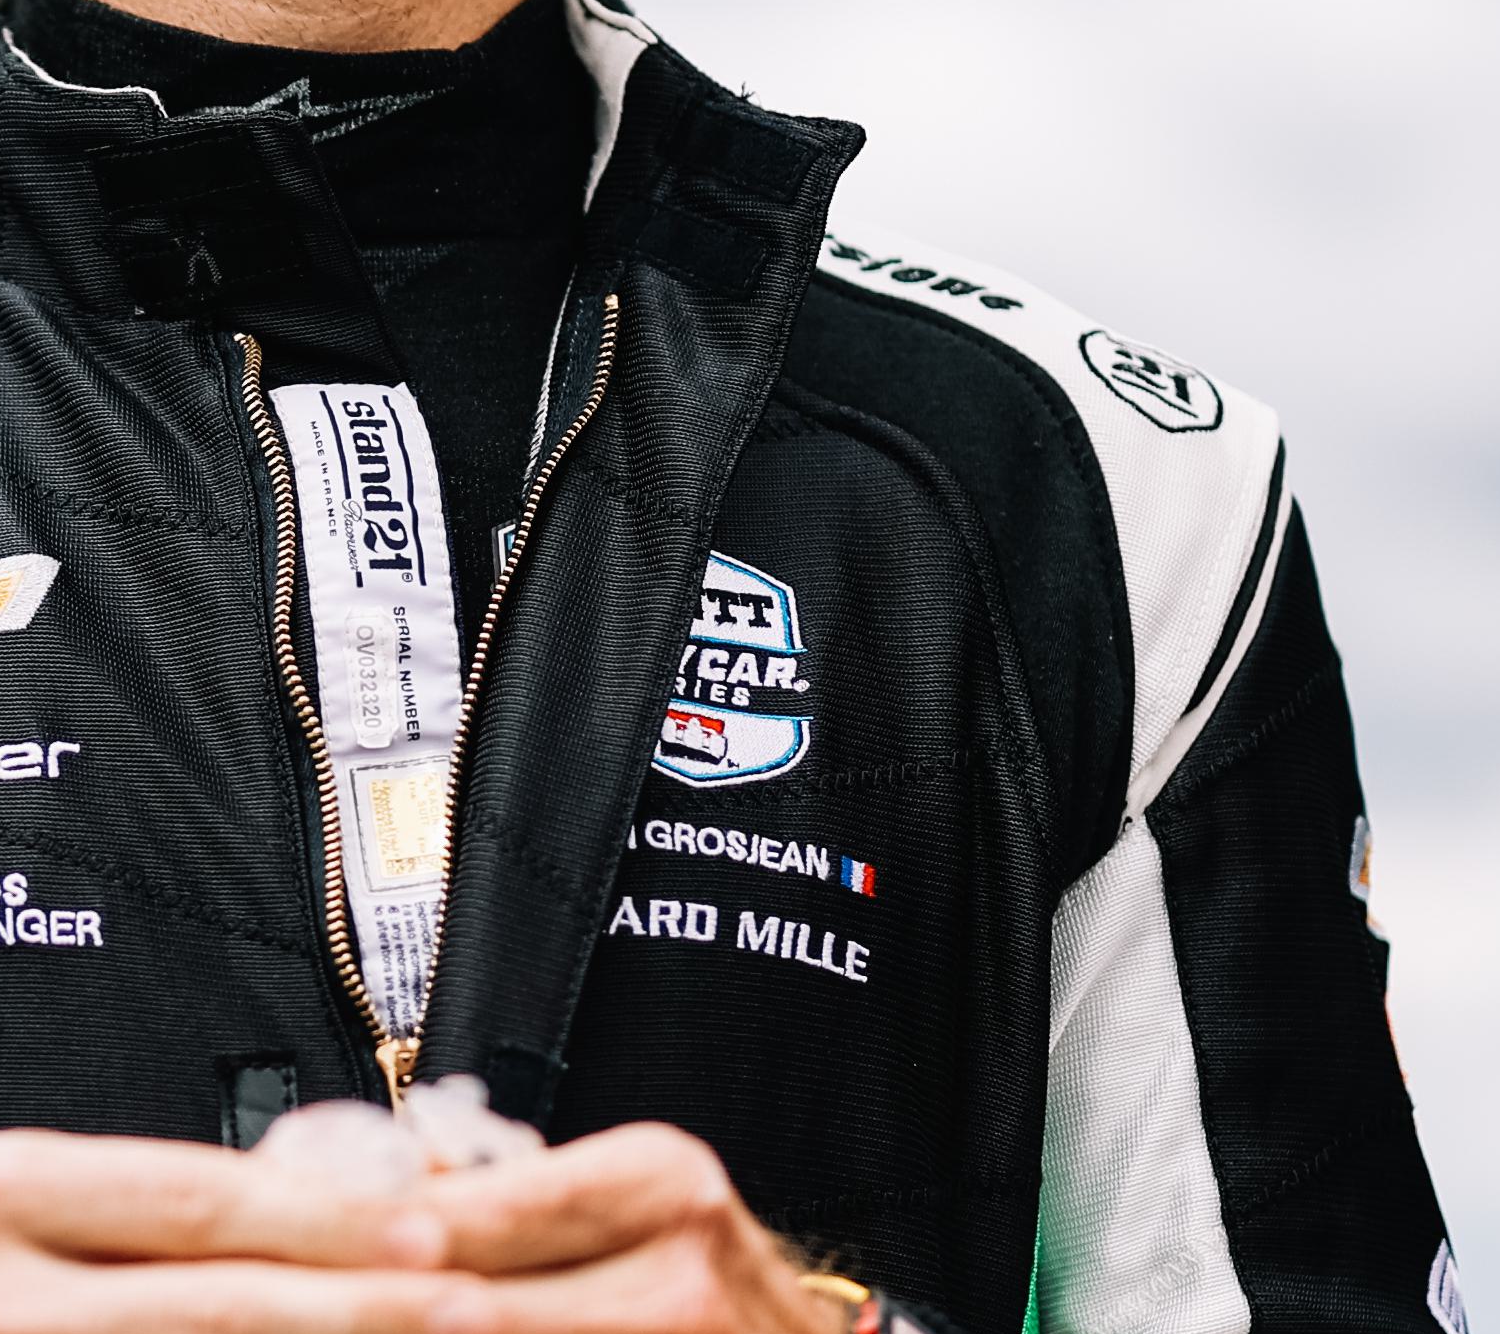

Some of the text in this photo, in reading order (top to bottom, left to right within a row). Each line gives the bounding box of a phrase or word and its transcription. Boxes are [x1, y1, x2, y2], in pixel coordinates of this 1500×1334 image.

[823, 233, 1024, 310] stone
[310, 420, 325, 457] MADE
[323, 479, 337, 537] FRANCE
[341, 401, 404, 511] stand
[691, 588, 774, 628] TT
[393, 606, 421, 743] SERIAL NUMBER
[645, 820, 830, 881] GROSJEAN
[602, 896, 870, 983] ARD MILLE
